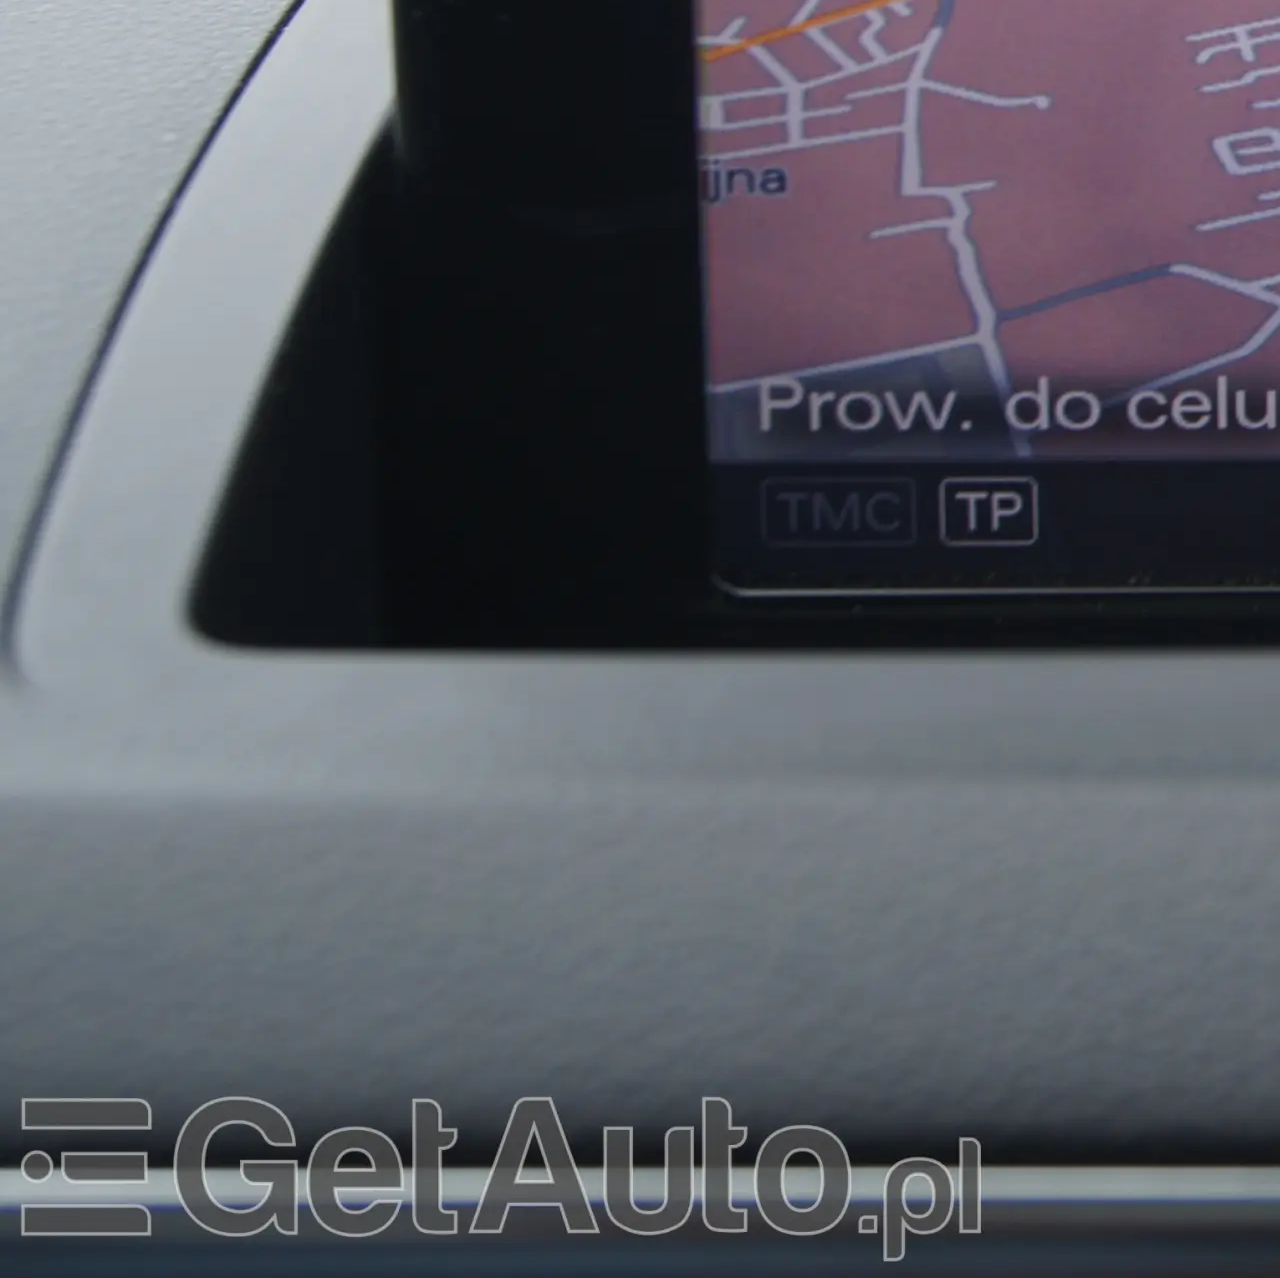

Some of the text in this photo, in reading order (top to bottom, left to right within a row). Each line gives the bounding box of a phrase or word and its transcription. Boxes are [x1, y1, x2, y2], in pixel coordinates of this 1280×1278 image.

[760, 376, 1279, 431] Prow. do celu
[776, 491, 902, 531] TMC
[955, 490, 1024, 532] TP
